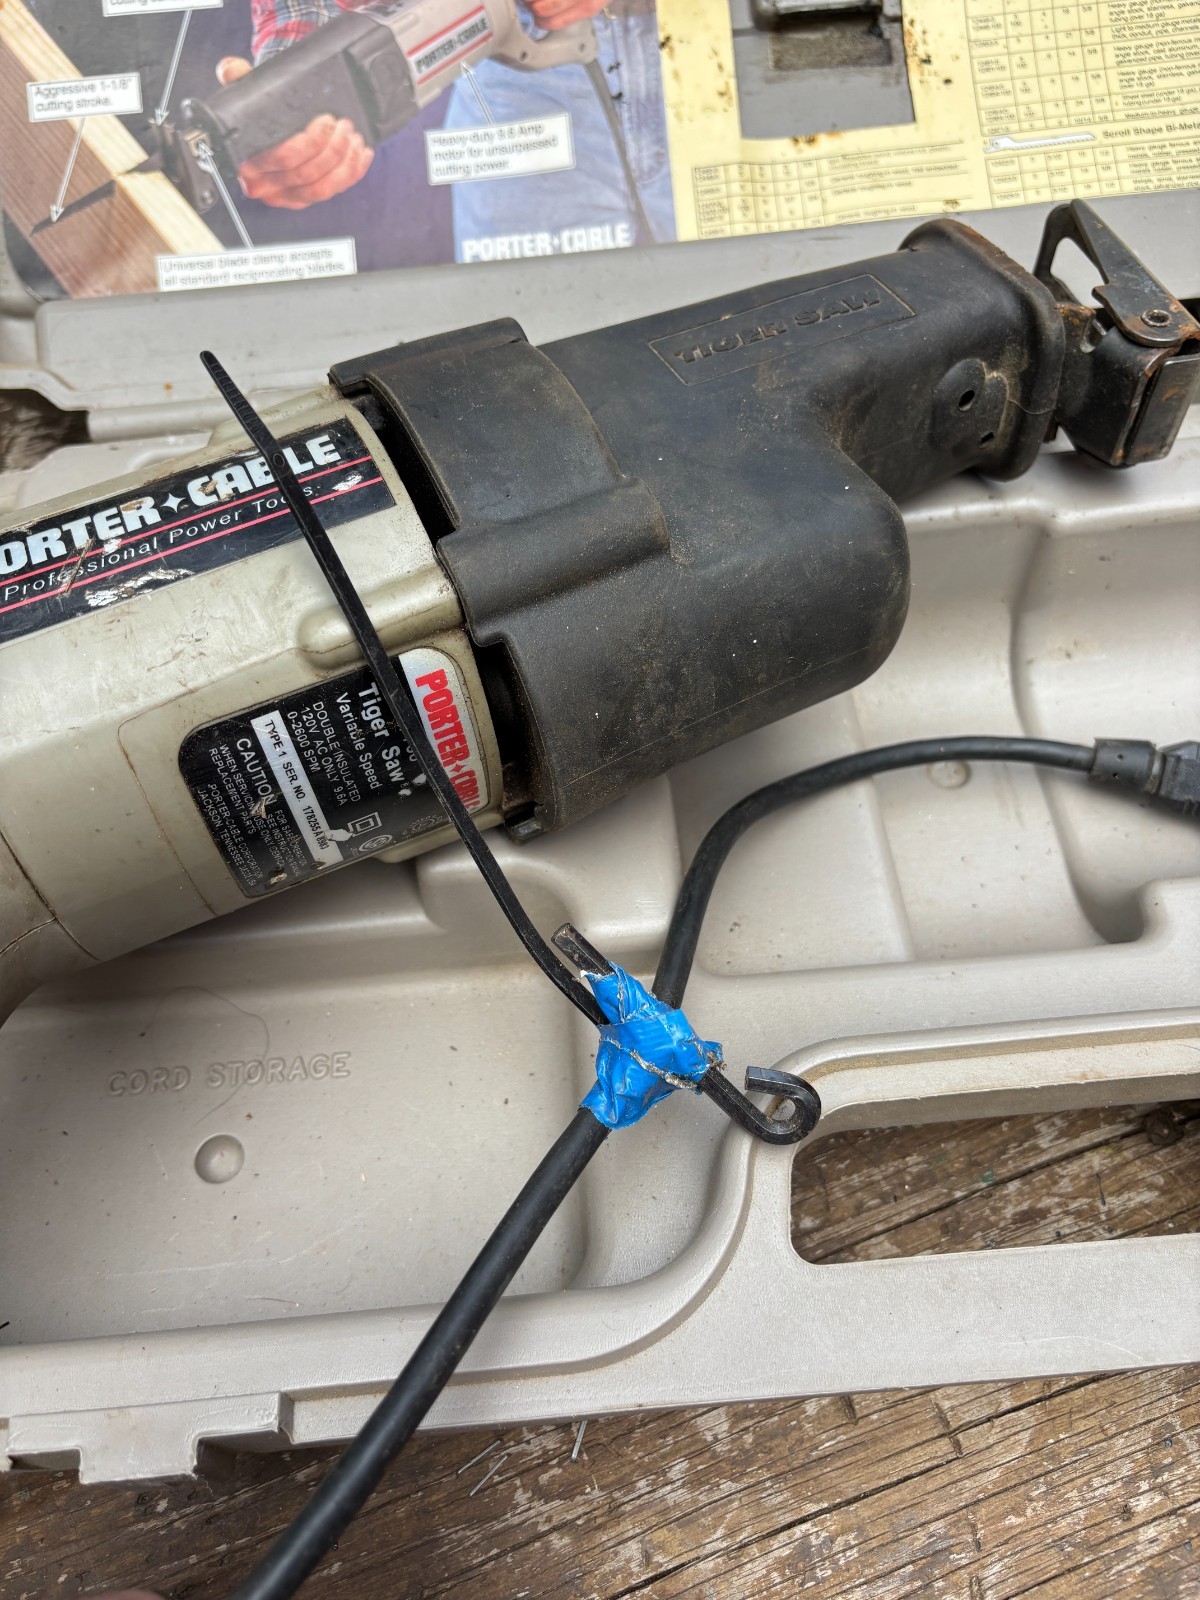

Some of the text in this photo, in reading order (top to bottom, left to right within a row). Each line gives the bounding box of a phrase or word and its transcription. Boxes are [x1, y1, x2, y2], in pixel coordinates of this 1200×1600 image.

[34, 81, 97, 98] Aggressive
[35, 99, 73, 113] cutting
[461, 223, 633, 263] PORTER CABLE
[794, 289, 881, 326] SAW
[169, 508, 243, 549] Power
[252, 486, 315, 513] Tos
[287, 711, 321, 772] 0-2600 SPM
[312, 701, 361, 801] DOUBLE INSULATED
[336, 692, 383, 789] Variable Speed
[358, 682, 405, 782] Tiger Saw
[415, 669, 469, 766] PORTER
[209, 748, 245, 810] REPLACEMENT
[239, 811, 256, 834] PARTS
[219, 744, 238, 772] WHEN
[233, 772, 261, 813] SERVICIN
[236, 738, 277, 805] CAUTION
[274, 809, 287, 825] FOR
[281, 825, 295, 842] SAFE
[265, 720, 284, 749] TYPE
[282, 762, 298, 785] SER.
[293, 784, 308, 803] NO.
[301, 707, 348, 806] 120V AC ONLY 9.6A
[207, 784, 244, 843] PORTER-CABLE
[107, 1051, 352, 1097] CORD STORAGE
